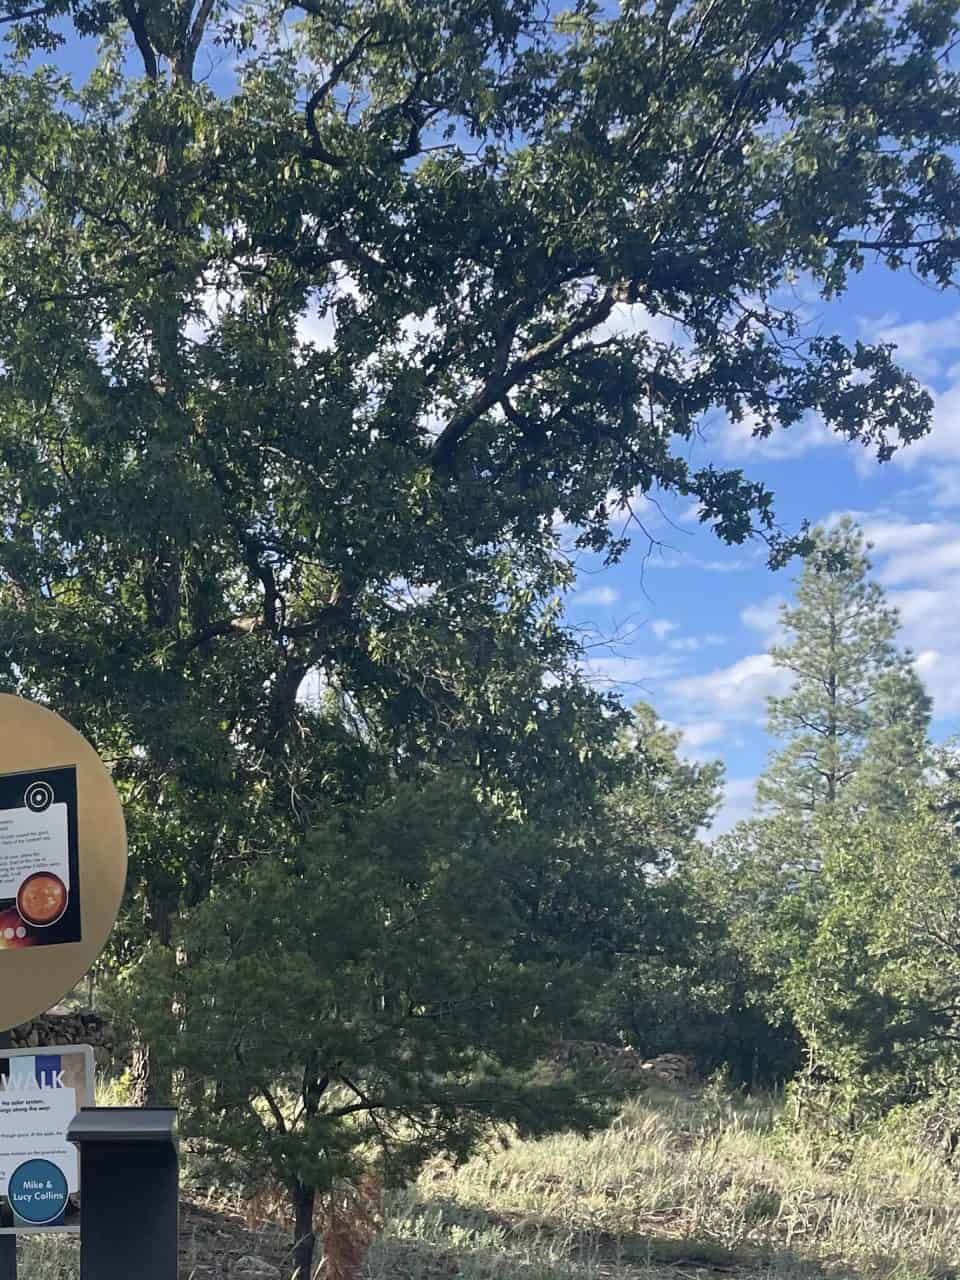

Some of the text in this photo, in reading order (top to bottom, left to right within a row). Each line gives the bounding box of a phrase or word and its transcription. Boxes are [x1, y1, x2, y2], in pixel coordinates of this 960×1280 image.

[1, 1070, 65, 1092] WALK
[23, 1179, 53, 1190] Mike &
[13, 1191, 64, 1203] Lucy Collins
